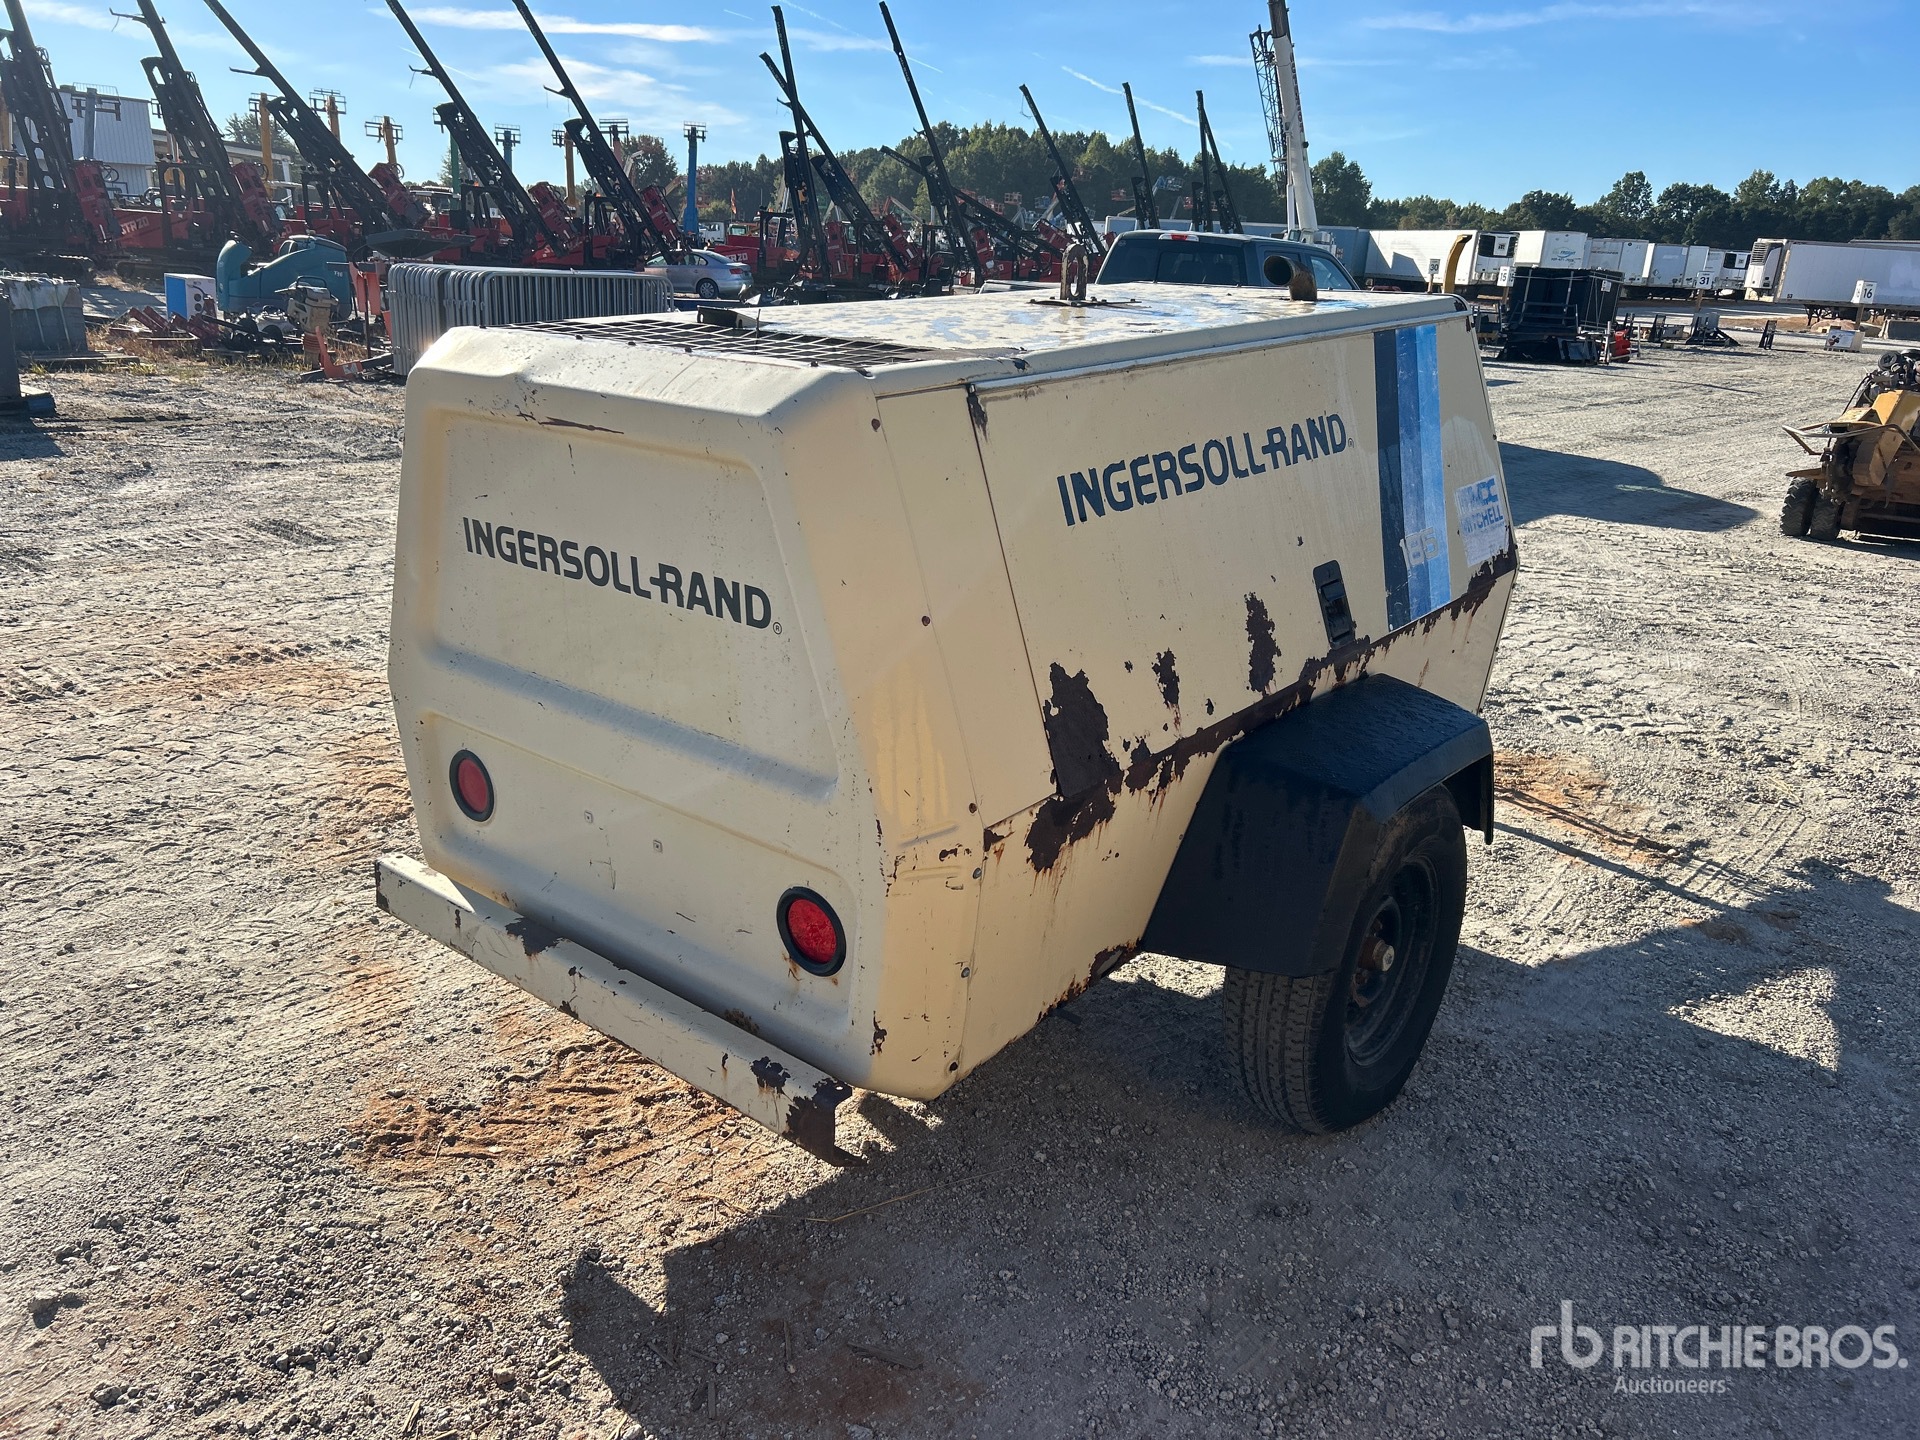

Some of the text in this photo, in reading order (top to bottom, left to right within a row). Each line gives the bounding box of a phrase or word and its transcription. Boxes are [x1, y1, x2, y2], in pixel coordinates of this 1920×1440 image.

[1429, 263, 1439, 271] 30
[1500, 272, 1507, 282] 15
[1699, 276, 1710, 285] 31
[1863, 288, 1873, 299] 16
[1057, 413, 1347, 527] INGERSOLL-RAND
[462, 516, 772, 630] INGERSOLL-RAND
